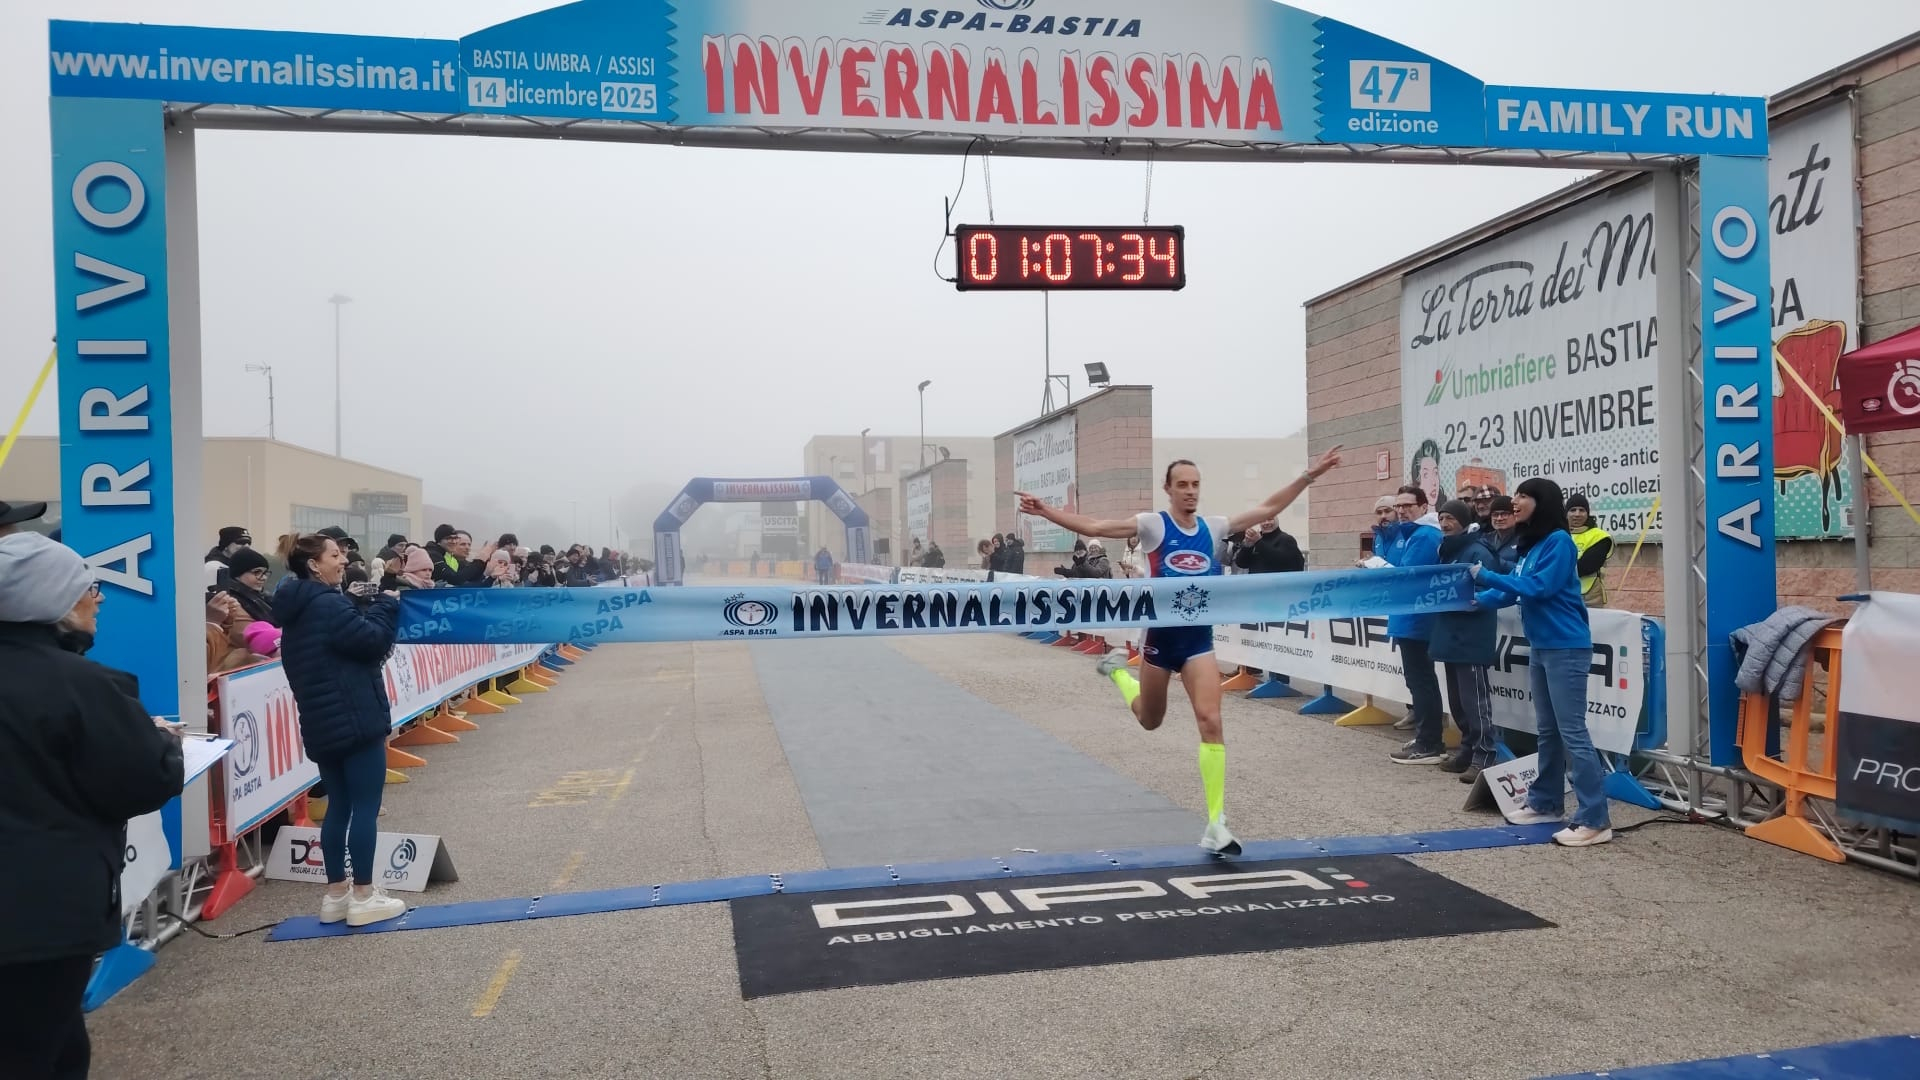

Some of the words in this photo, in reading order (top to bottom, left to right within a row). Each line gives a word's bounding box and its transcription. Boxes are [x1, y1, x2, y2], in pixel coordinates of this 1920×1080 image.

[886, 8, 1141, 37] ASPA-BASTIA
[51, 48, 456, 92] www.invernalissima.it
[473, 49, 528, 70] BASTIA
[533, 52, 591, 73] UMBRA
[608, 56, 655, 76] ASSISI
[473, 81, 499, 104] 14
[506, 79, 598, 107] dicembre
[603, 86, 655, 110] 2025
[703, 34, 1282, 131] INVERNALISSIMA
[1347, 113, 1439, 134] edizione
[1498, 98, 1652, 137] FAMILY
[1666, 105, 1753, 139] RUN
[1411, 284, 1452, 350] La
[1449, 260, 1534, 336] Terra
[1540, 241, 1588, 310] dei
[1453, 353, 1556, 400] Umbriafiere
[1567, 316, 1657, 375] BASTIA
[71, 160, 153, 596] ARRIVO
[1711, 205, 1762, 549] ARRIVO
[1444, 414, 1505, 454] 22-23
[1513, 385, 1655, 444] NOVEMBRE
[1513, 462, 1539, 478] fiera
[1543, 461, 1555, 475] di
[1558, 455, 1610, 474] vintage
[1620, 449, 1659, 467] antic
[1611, 475, 1662, 496] collezi
[764, 516, 798, 527] USCITA
[431, 590, 488, 617] ASPA
[596, 589, 653, 615] ASPA
[791, 585, 1157, 633] INVERNALISSIMA
[1287, 594, 1333, 619] ASPA
[1414, 586, 1459, 611] ASPA
[397, 617, 453, 642] ASPA
[568, 615, 624, 642] ASPA
[748, 628, 778, 636] BASTIA
[1241, 638, 1273, 652] ABBIGLIAMENTO
[1273, 643, 1314, 659] PERSONALIZZATO
[1331, 654, 1375, 670] ABBIGLIAMENTO
[1377, 662, 1405, 676] PERSONA
[290, 866, 311, 874] MISURA
[812, 869, 1337, 929] DIPA
[826, 915, 1104, 947] ABBIGLIAMENTO
[1117, 894, 1397, 924] PERSONALIZZATO
